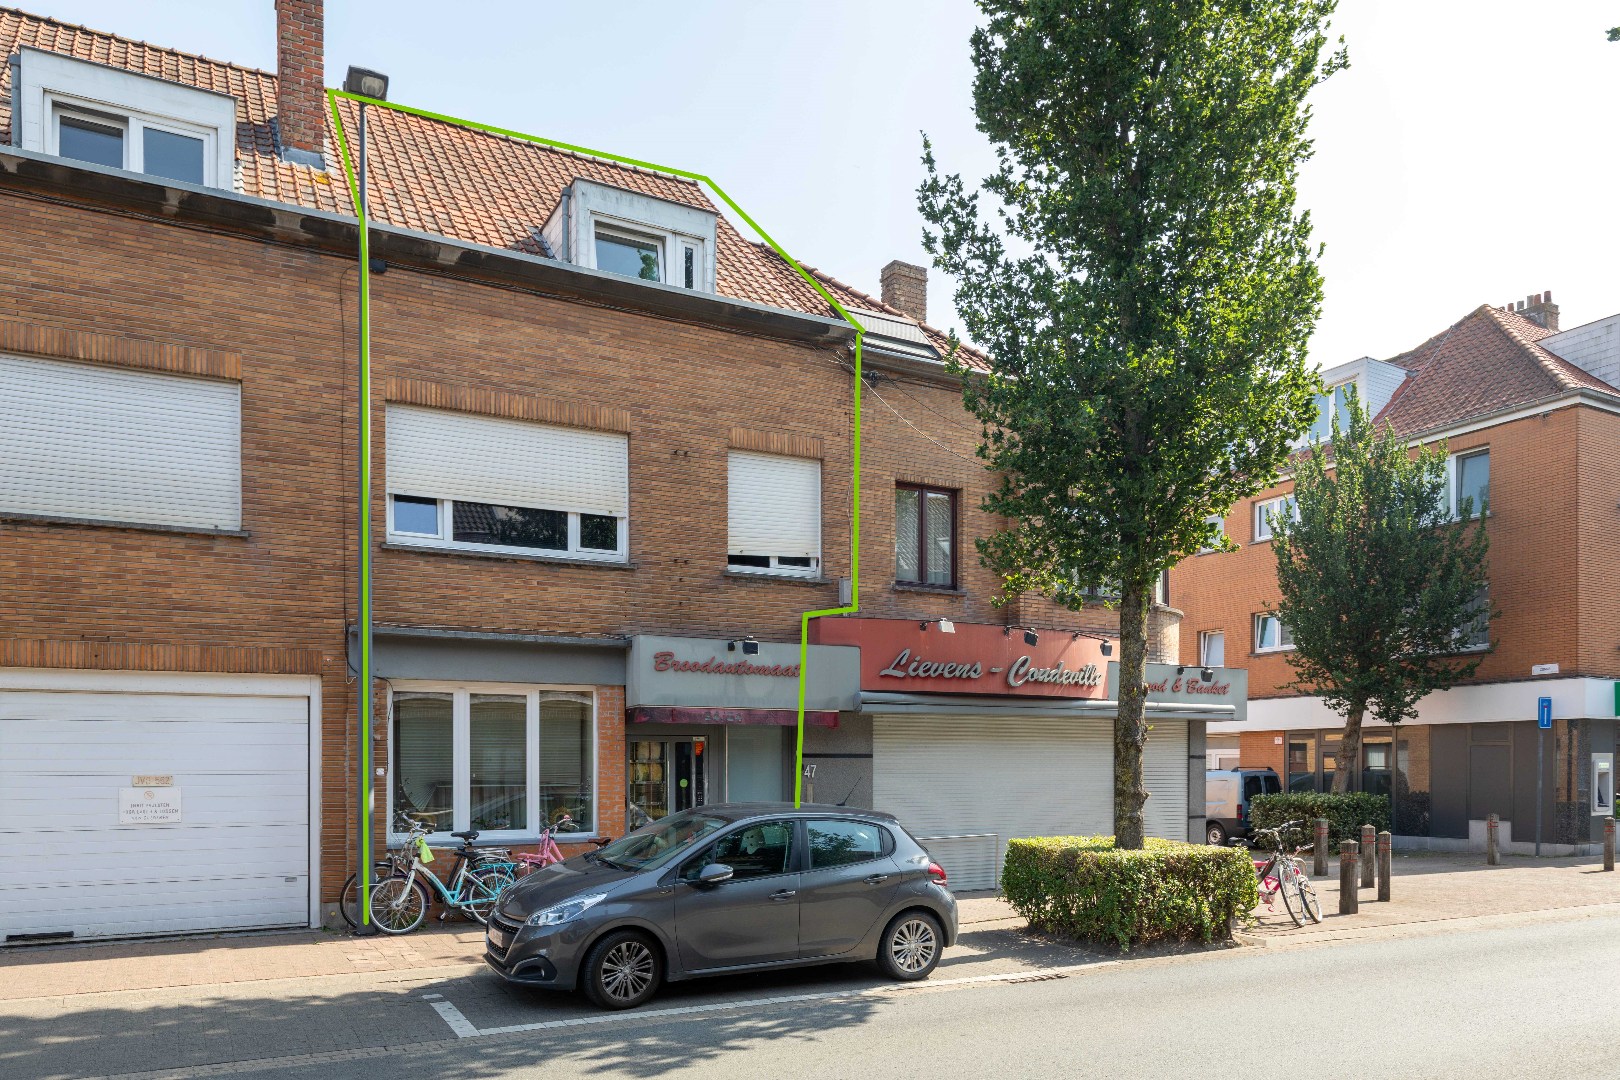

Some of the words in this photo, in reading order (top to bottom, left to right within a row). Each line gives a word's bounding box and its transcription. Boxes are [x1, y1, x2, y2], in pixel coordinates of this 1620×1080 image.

[880, 648, 984, 679] Lievens
[1148, 678, 1168, 693] ood
[1172, 677, 1182, 692] &
[1186, 677, 1230, 695] Banket
[804, 764, 817, 778] 47
